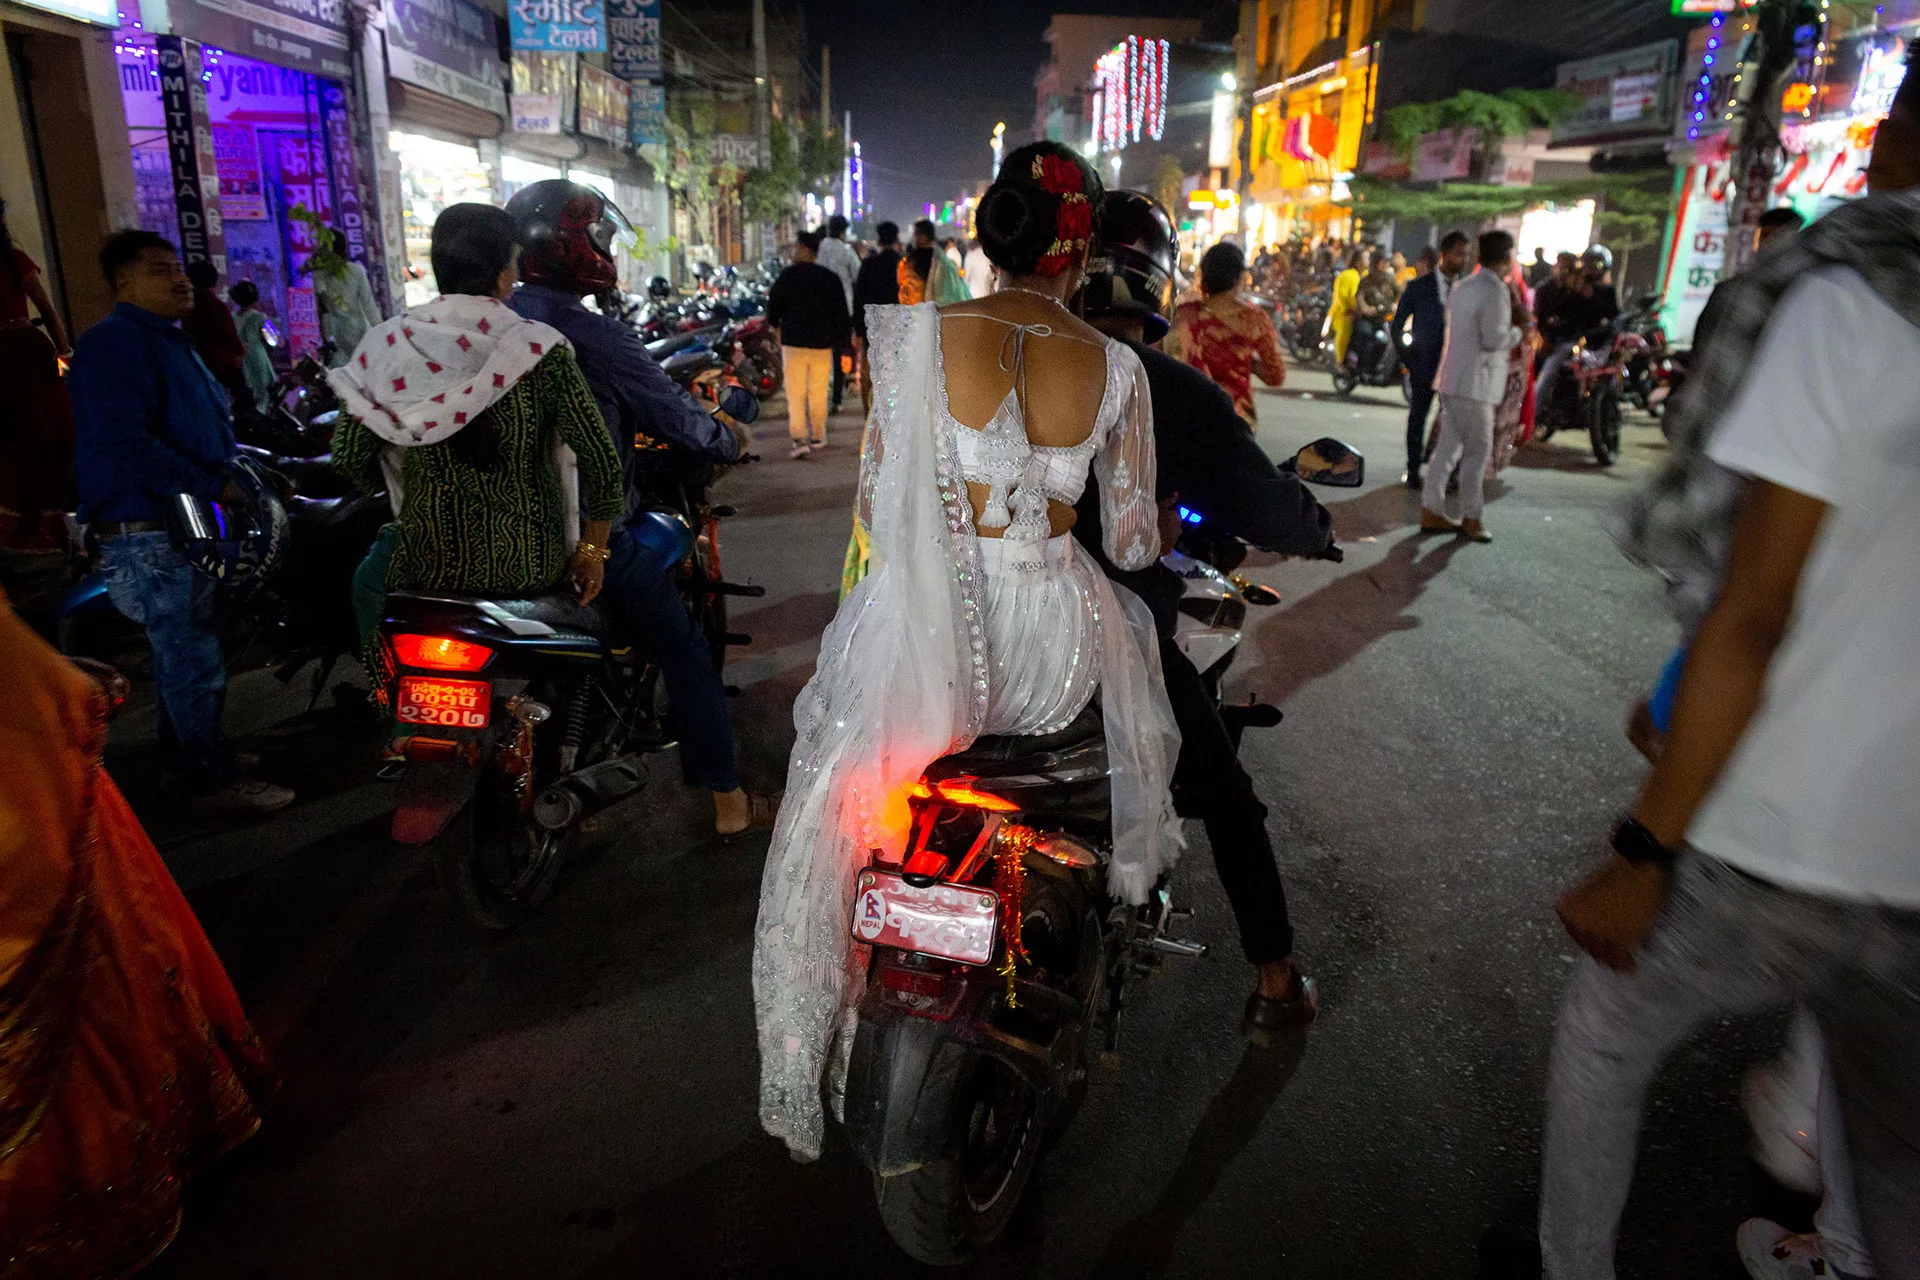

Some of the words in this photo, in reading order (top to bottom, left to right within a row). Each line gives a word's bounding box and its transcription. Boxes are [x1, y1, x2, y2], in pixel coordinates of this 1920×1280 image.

[163, 76, 198, 199] MITHILA
[328, 107, 357, 204] MITHILA
[402, 705, 485, 727] २२०७
[860, 919, 881, 930] NEPAL
